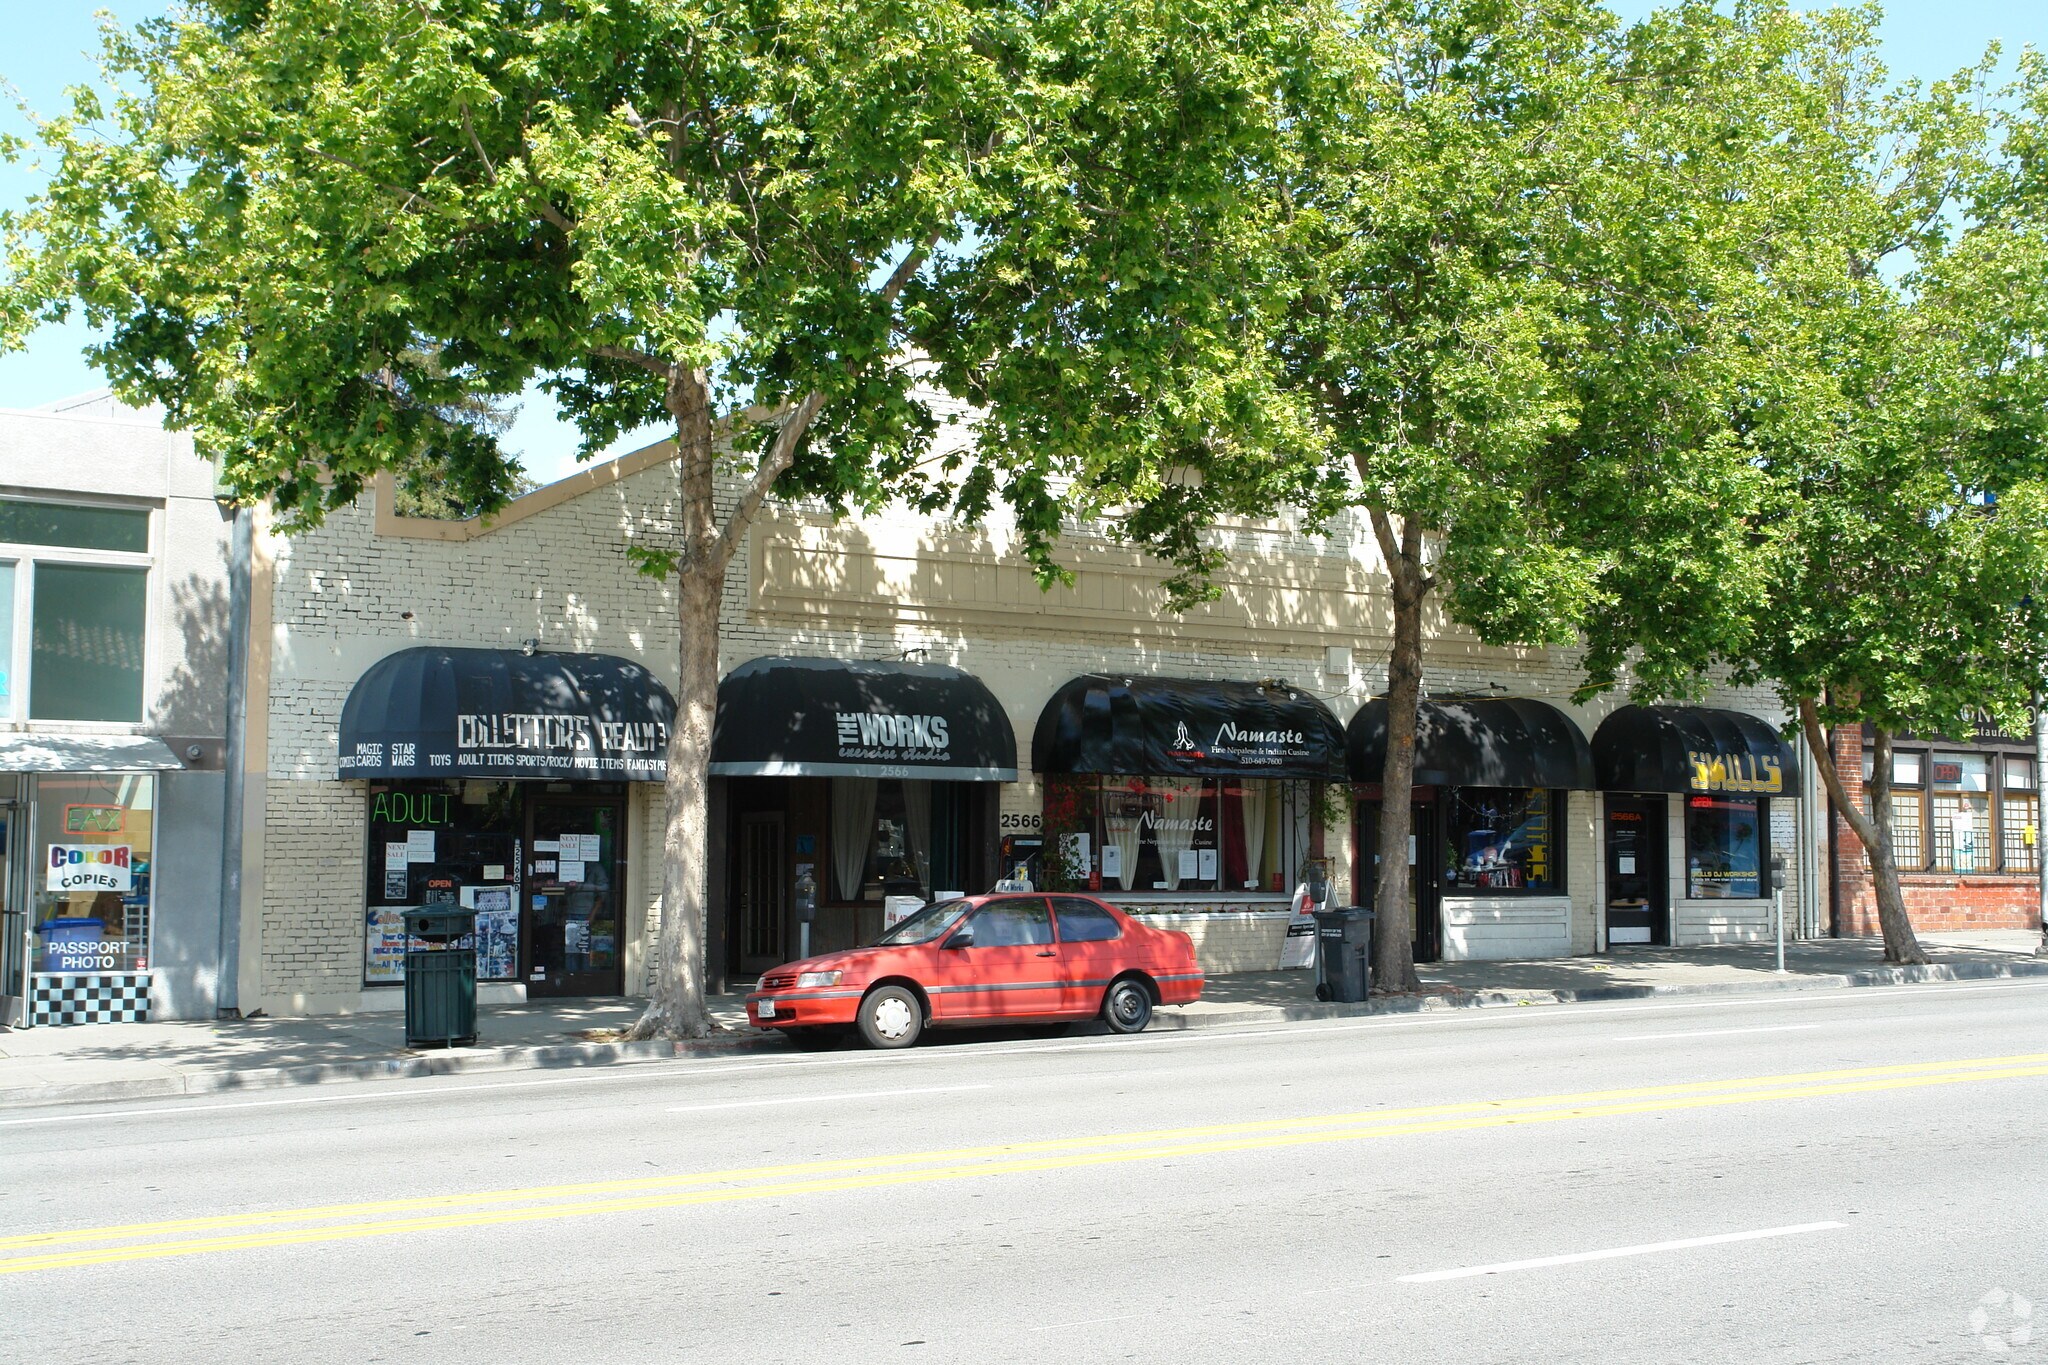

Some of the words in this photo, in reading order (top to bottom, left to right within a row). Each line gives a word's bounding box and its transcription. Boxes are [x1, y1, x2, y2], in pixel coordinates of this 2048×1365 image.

[600, 722, 654, 751] REALM
[658, 722, 666, 746] 3
[836, 712, 858, 745] THE
[857, 712, 949, 748] WORKS
[1215, 722, 1304, 745] Namaste
[356, 743, 383, 754] MAGIC
[392, 743, 416, 754] STAR
[839, 746, 897, 759] exercise
[902, 746, 950, 760] studio
[1212, 746, 1226, 754] Fine
[1227, 746, 1256, 755] Nepalese
[1266, 747, 1287, 755] Indian
[356, 756, 382, 766] CARDS
[392, 754, 415, 766] WARS
[430, 754, 452, 766] TOYS
[458, 754, 484, 766] ADULT
[487, 754, 514, 766] ITEMS
[574, 756, 598, 769] MOVIE
[600, 758, 624, 770] ITEMS
[626, 758, 658, 771] FANTASY
[658, 760, 667, 772] POS
[881, 766, 909, 776] 2566
[1689, 751, 1782, 792] SKILLS
[1935, 765, 1960, 780] OPEN
[372, 792, 453, 824] ADULT
[68, 809, 122, 830] FAX
[1001, 814, 1040, 828] 2566
[1134, 810, 1213, 834] Namaste
[51, 846, 129, 868] COLOR
[61, 874, 118, 888] COPIES
[428, 880, 452, 888] OPEN
[48, 942, 130, 954] PASSPORT
[62, 956, 114, 968] PHOTO
